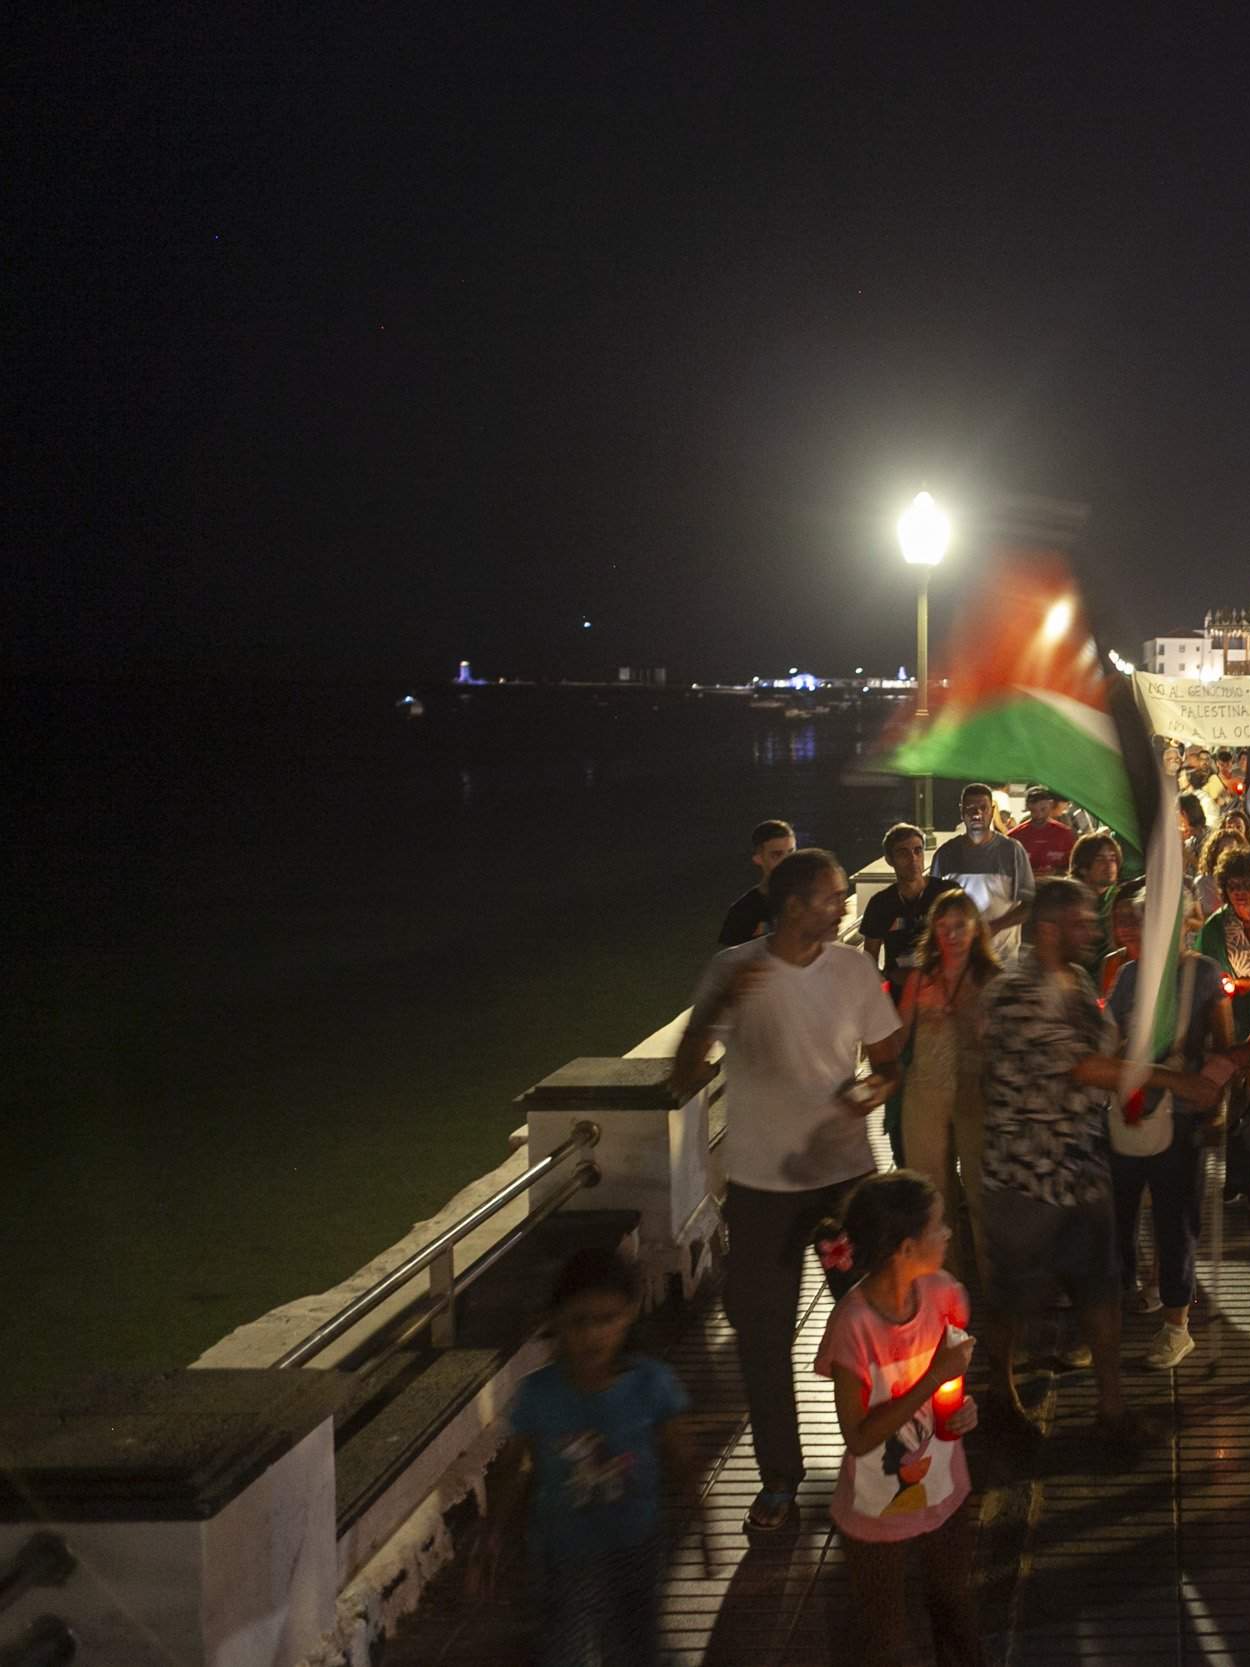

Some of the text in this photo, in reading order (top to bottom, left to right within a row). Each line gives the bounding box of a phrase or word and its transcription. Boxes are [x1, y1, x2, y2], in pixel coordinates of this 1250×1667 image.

[1148, 682, 1165, 696] NO
[1169, 685, 1184, 698] AL
[1180, 703, 1250, 719] PALESTINA
[1212, 727, 1227, 739] LA
